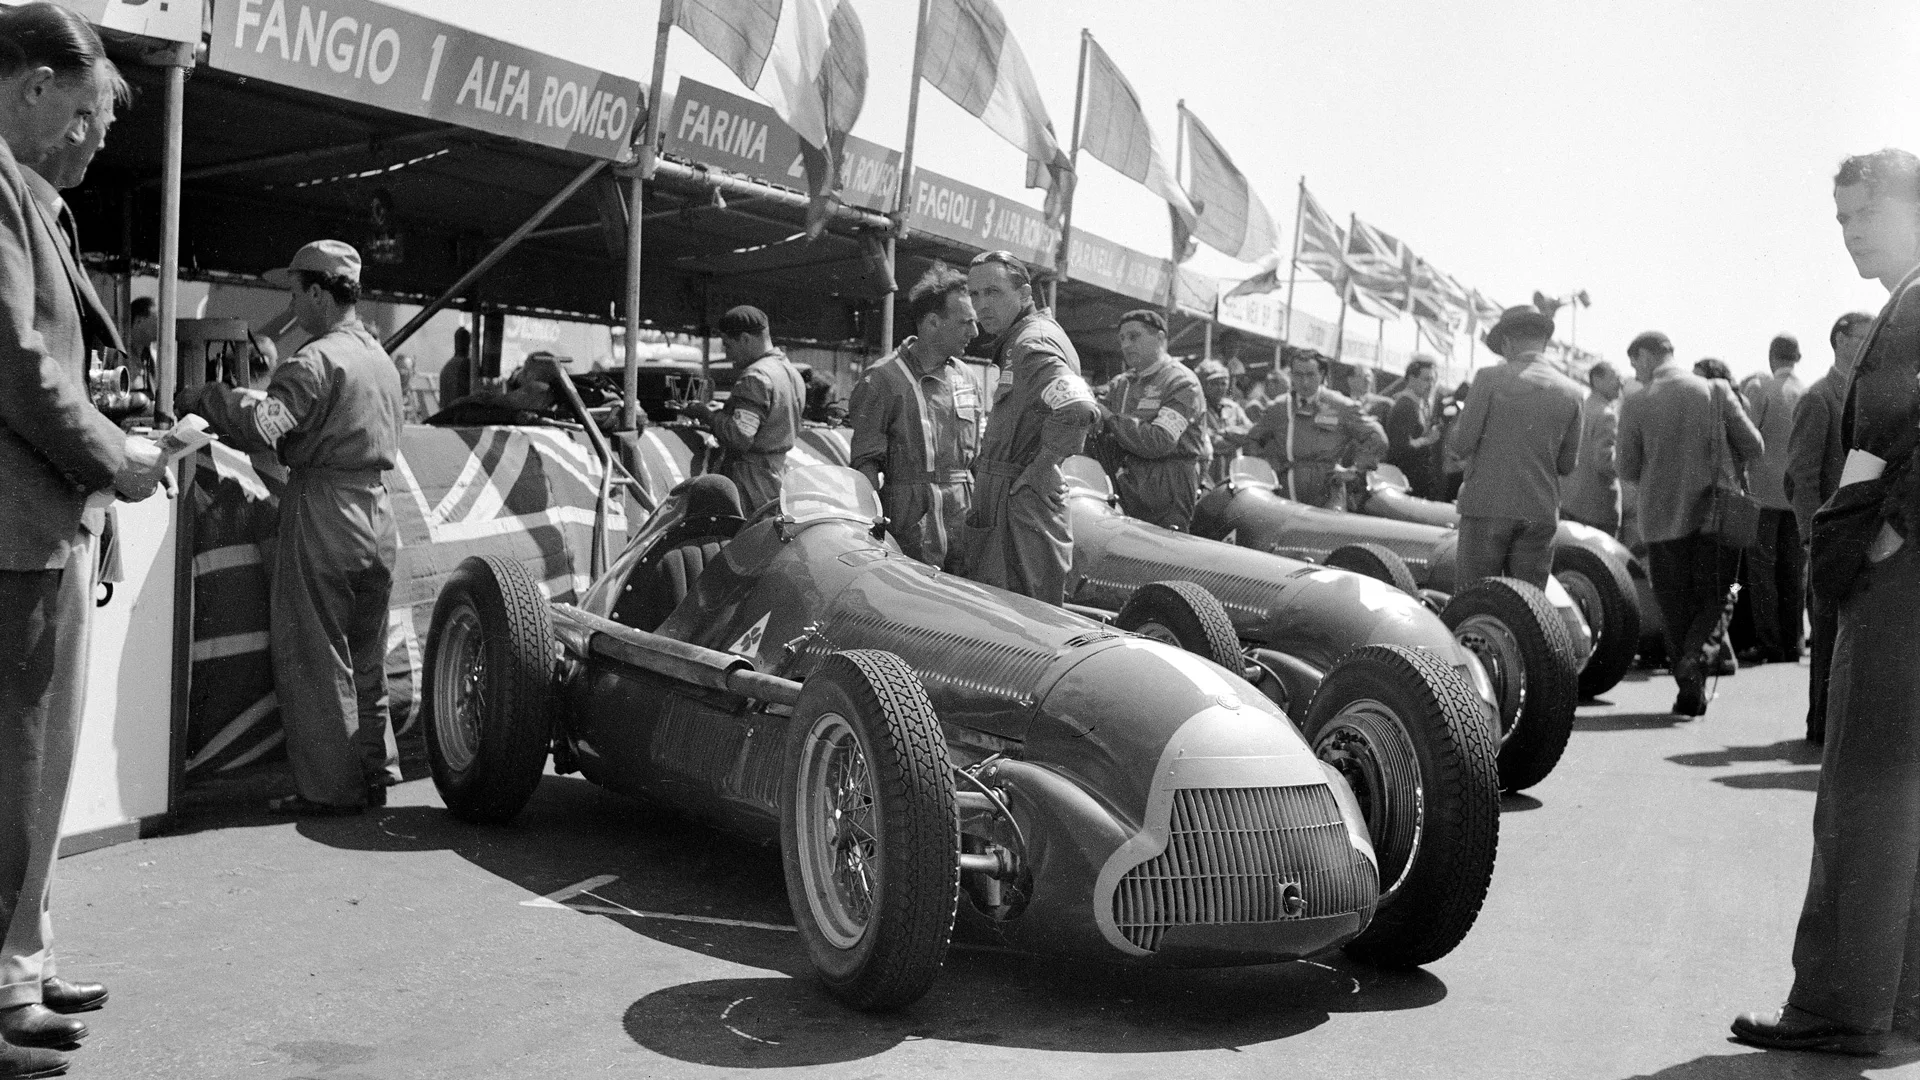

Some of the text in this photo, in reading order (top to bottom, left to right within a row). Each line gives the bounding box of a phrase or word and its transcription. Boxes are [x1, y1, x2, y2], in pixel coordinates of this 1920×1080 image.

[235, 0, 628, 141] FANGIO 1 ALFA ROMEO
[678, 100, 768, 163] FARINA
[852, 156, 898, 197] ROMEO
[916, 180, 977, 230] FAGIOLI
[982, 198, 996, 239] 3
